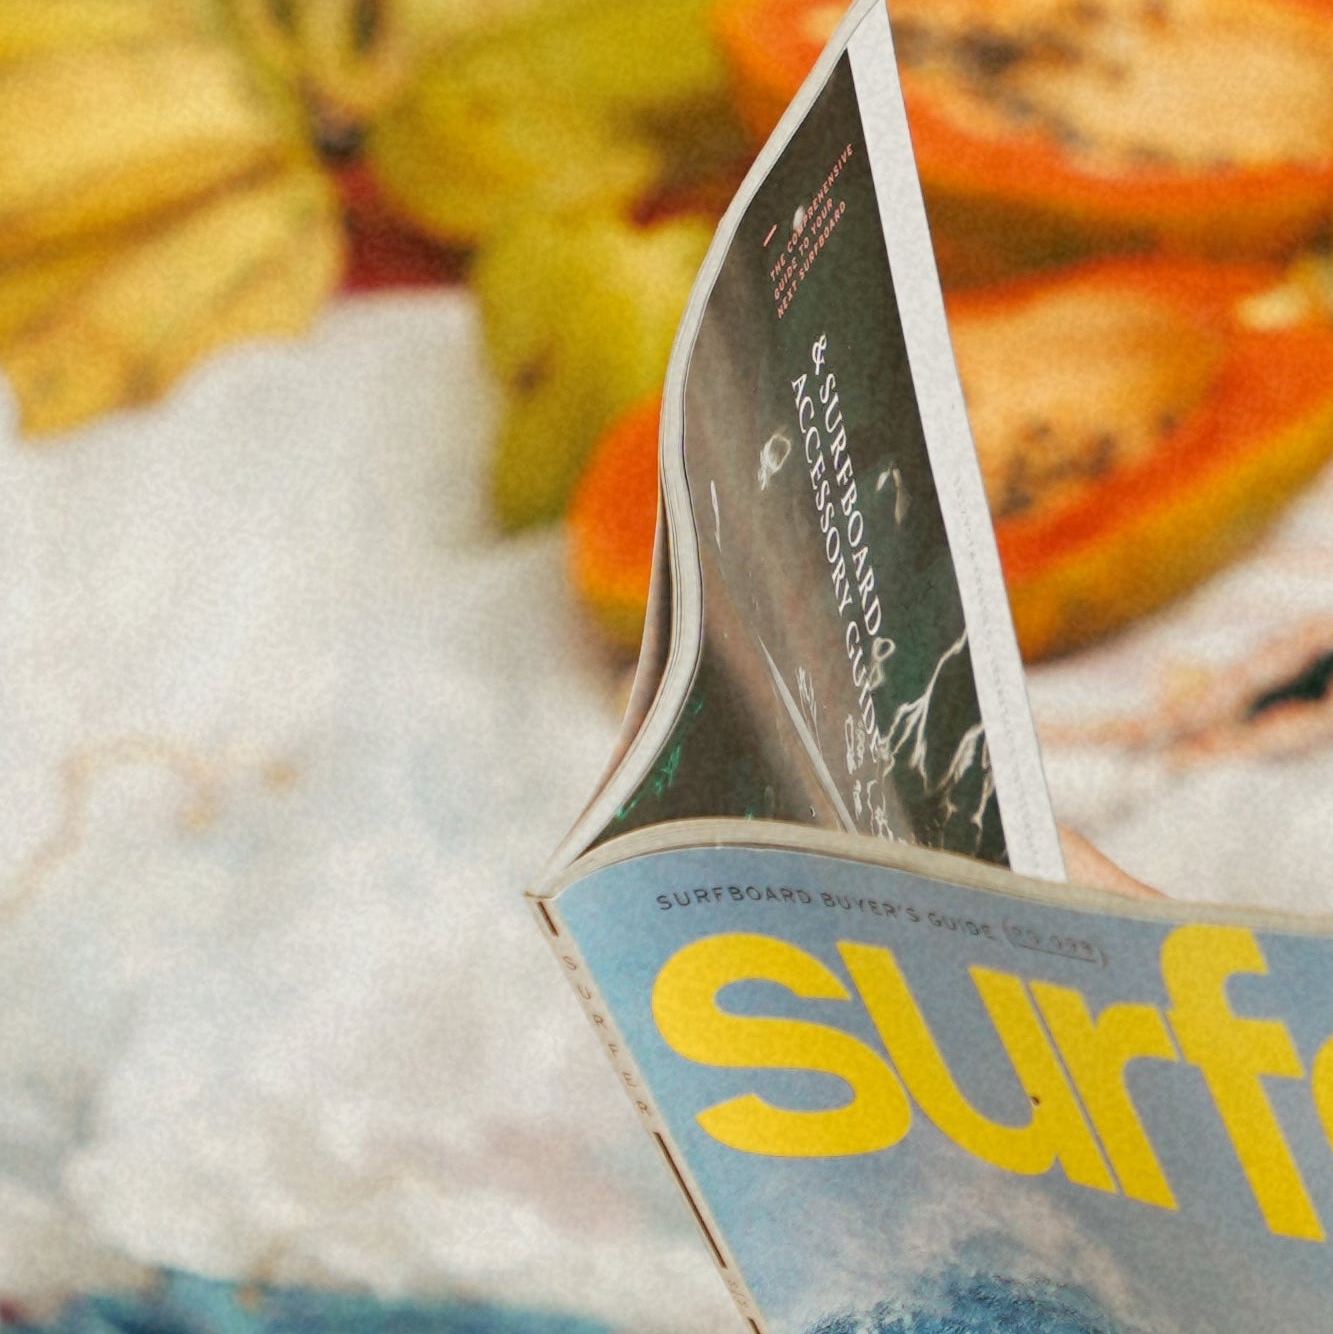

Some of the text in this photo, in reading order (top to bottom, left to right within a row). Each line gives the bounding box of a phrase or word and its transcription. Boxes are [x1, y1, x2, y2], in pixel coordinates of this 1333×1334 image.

[769, 143, 853, 281] THE COMPREHENSIVE
[774, 198, 833, 300] GUIDE TO YOUR
[777, 200, 846, 318] NEXT SURFBOARD
[812, 331, 882, 635] & SURFBOARD
[791, 373, 881, 763] ACCESSORY GUIDE
[656, 885, 812, 911] SURFBOARD
[820, 892, 921, 923] BUYER'S
[927, 912, 995, 941] GUIDE
[562, 955, 651, 1116] SURFER
